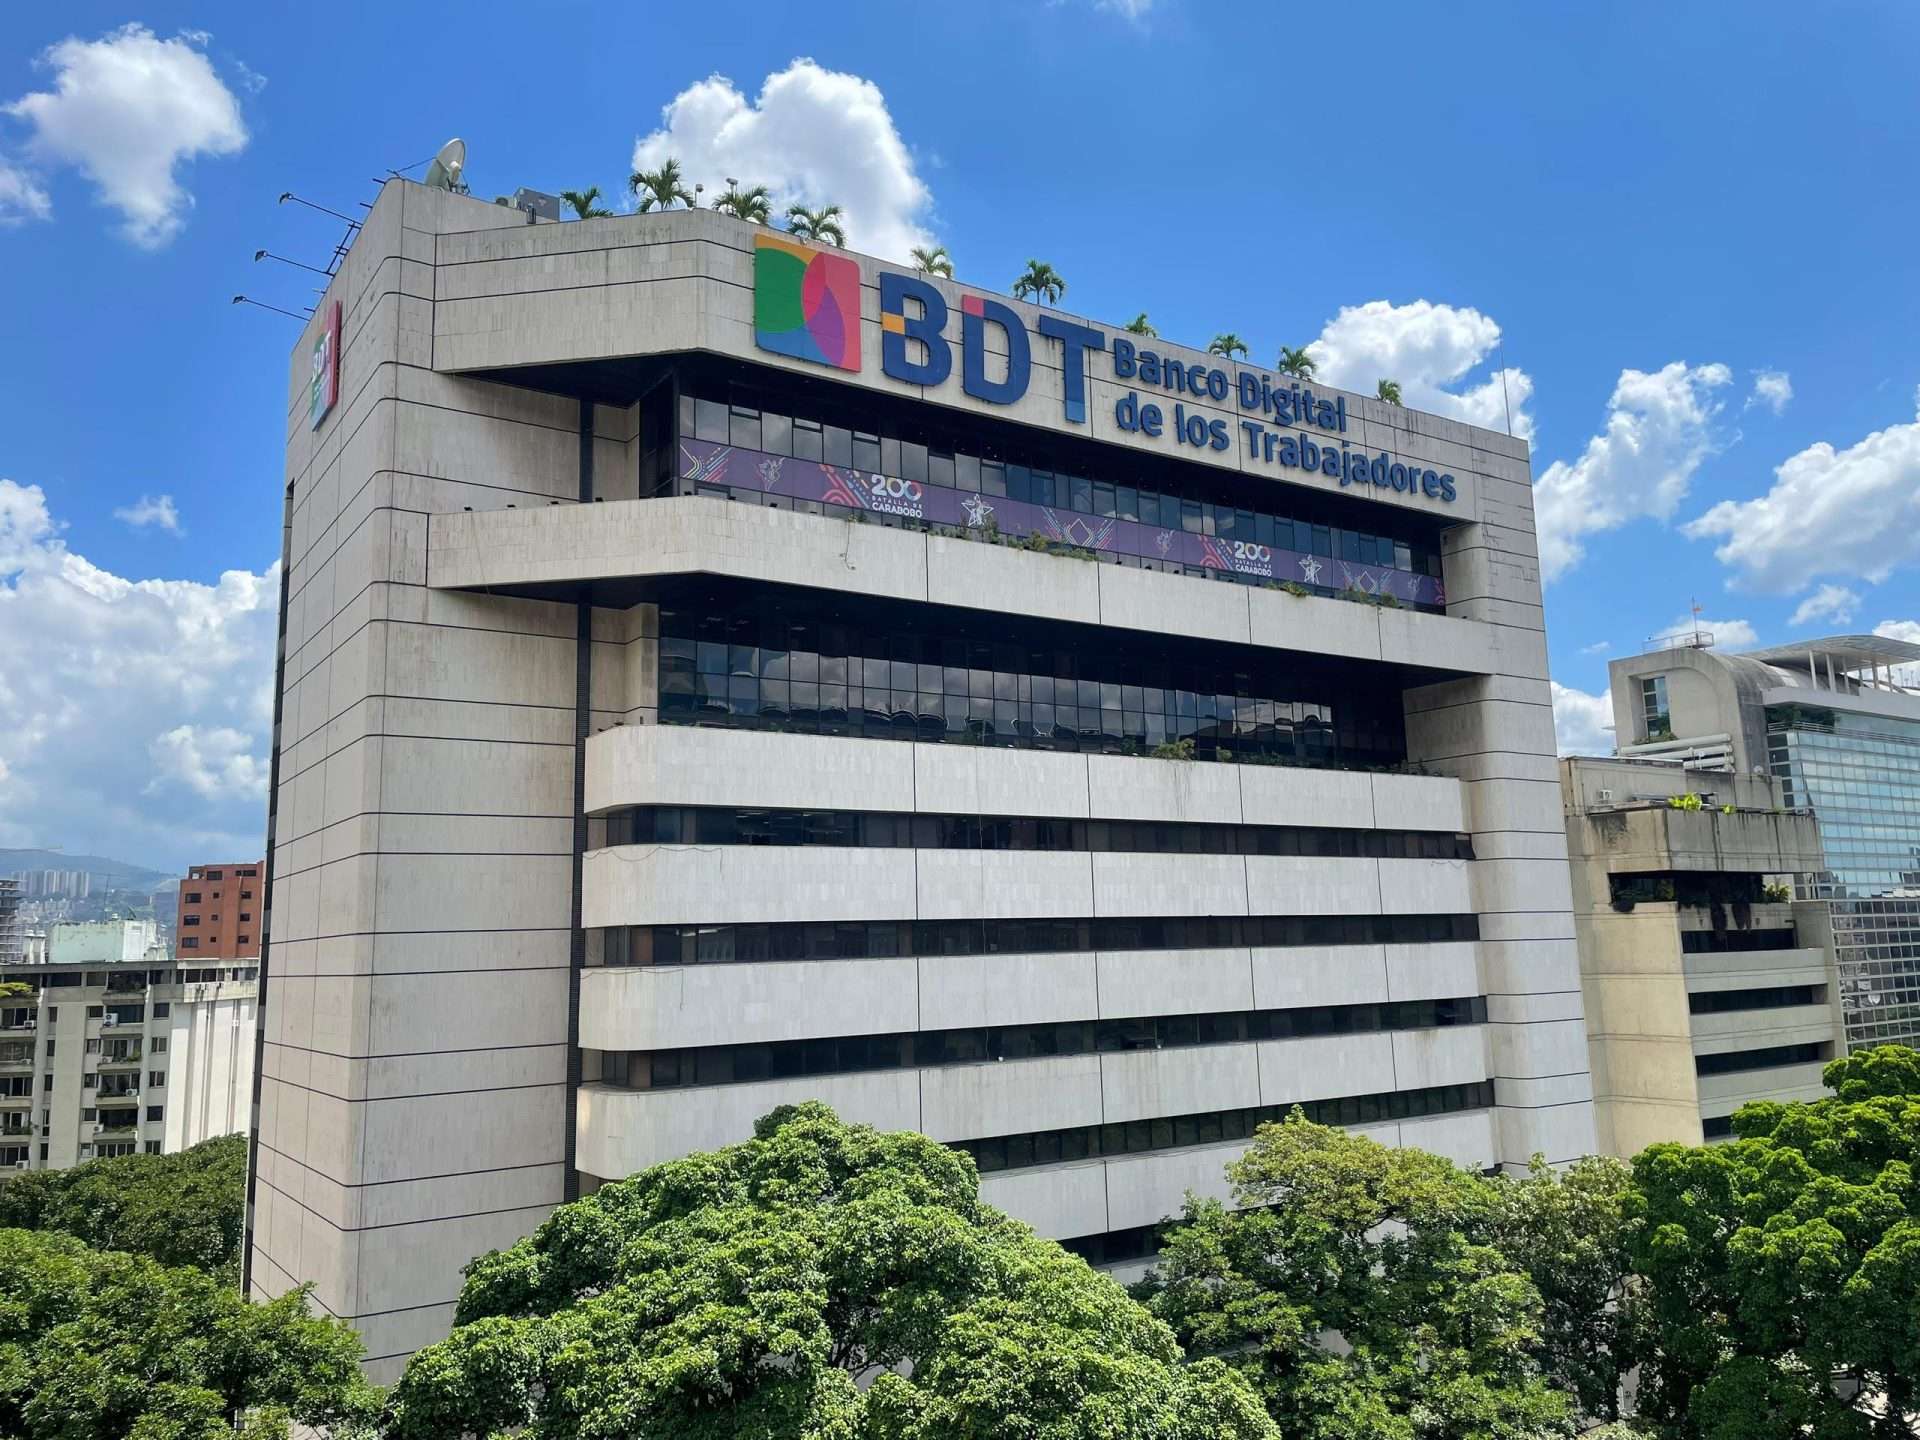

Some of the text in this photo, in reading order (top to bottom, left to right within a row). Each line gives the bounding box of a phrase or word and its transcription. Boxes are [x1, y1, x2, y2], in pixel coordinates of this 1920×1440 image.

[880, 272, 1105, 423] BDT
[1114, 338, 1347, 432] Banco Digital
[1115, 392, 1457, 502] de los Trabajadores
[871, 474, 922, 501] 200
[871, 502, 923, 519] CARABOBO
[1234, 540, 1270, 562] 200
